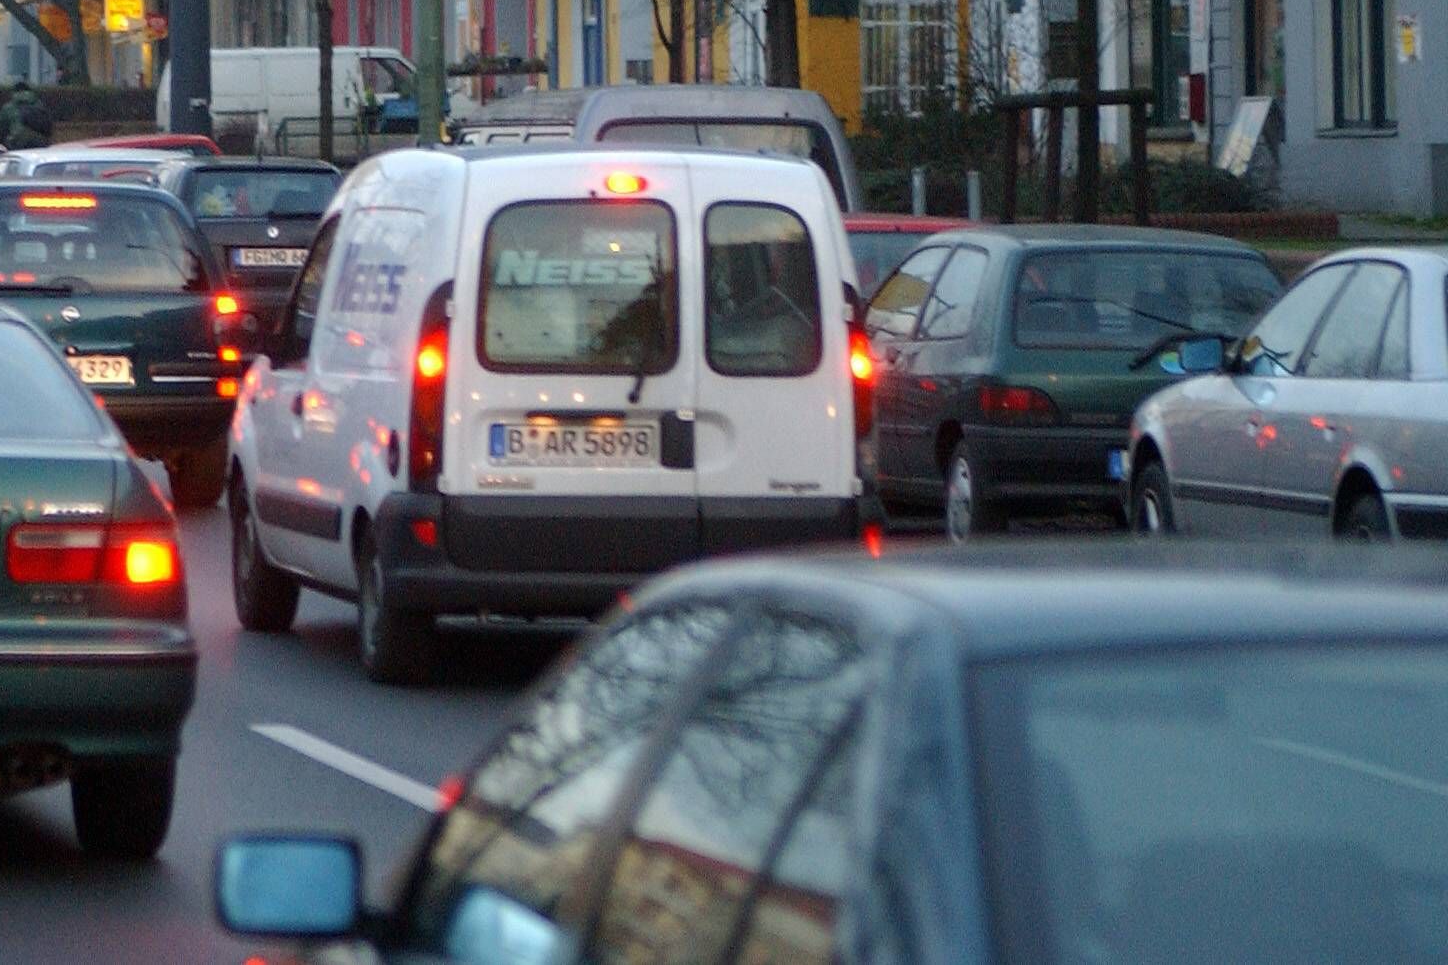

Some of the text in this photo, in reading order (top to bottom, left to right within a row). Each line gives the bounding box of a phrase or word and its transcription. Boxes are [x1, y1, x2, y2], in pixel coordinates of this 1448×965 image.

[508, 429, 650, 456] B AR 5898
